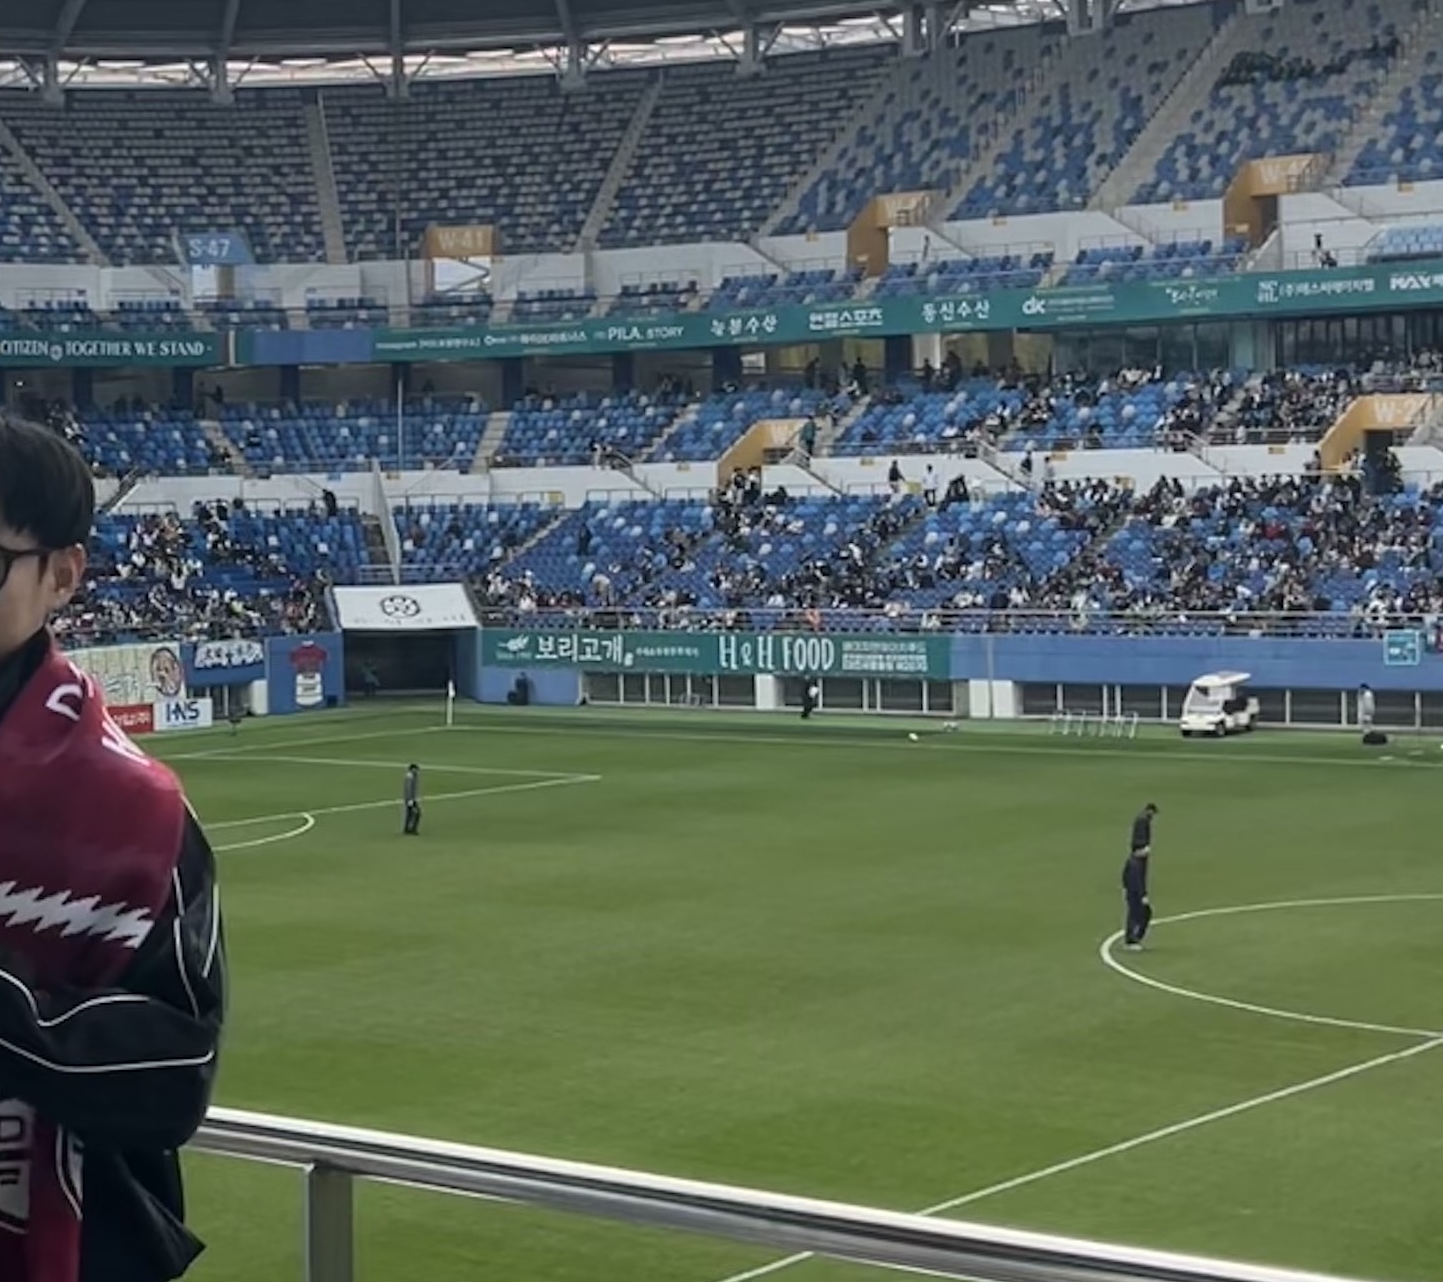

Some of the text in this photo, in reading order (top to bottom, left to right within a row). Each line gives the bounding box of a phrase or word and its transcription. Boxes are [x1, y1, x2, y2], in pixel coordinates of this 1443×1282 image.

[65, 340, 133, 357] TOGETHER
[134, 340, 158, 357] WE
[159, 340, 205, 357] STAND
[534, 634, 624, 664] 보리고개
[782, 636, 835, 671] FOOD
